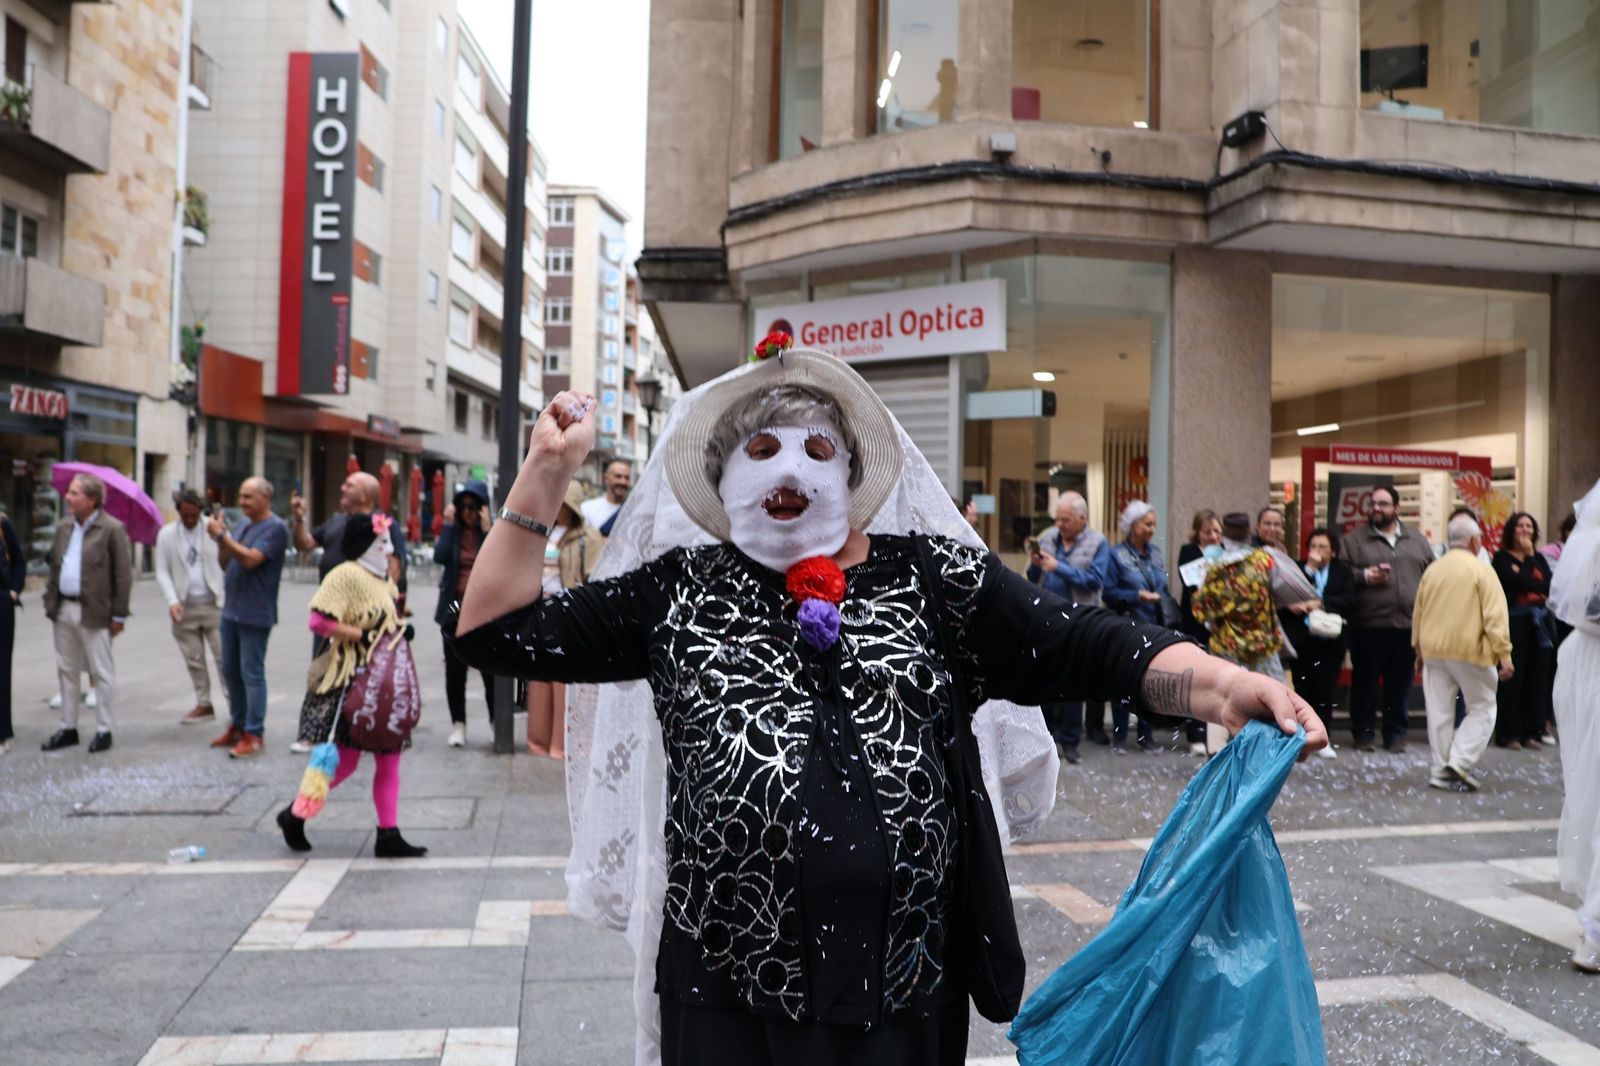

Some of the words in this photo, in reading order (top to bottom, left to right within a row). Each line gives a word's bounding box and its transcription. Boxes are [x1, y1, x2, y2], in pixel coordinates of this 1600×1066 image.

[311, 77, 348, 283] HOTEL
[604, 270, 619, 431] PHILIPS
[801, 312, 892, 346] General
[900, 304, 984, 341] Optica
[1336, 451, 1356, 463] MES
[1358, 452, 1369, 464] DE
[1372, 453, 1390, 465] LOS
[1392, 454, 1454, 467] PROGRESIVOS
